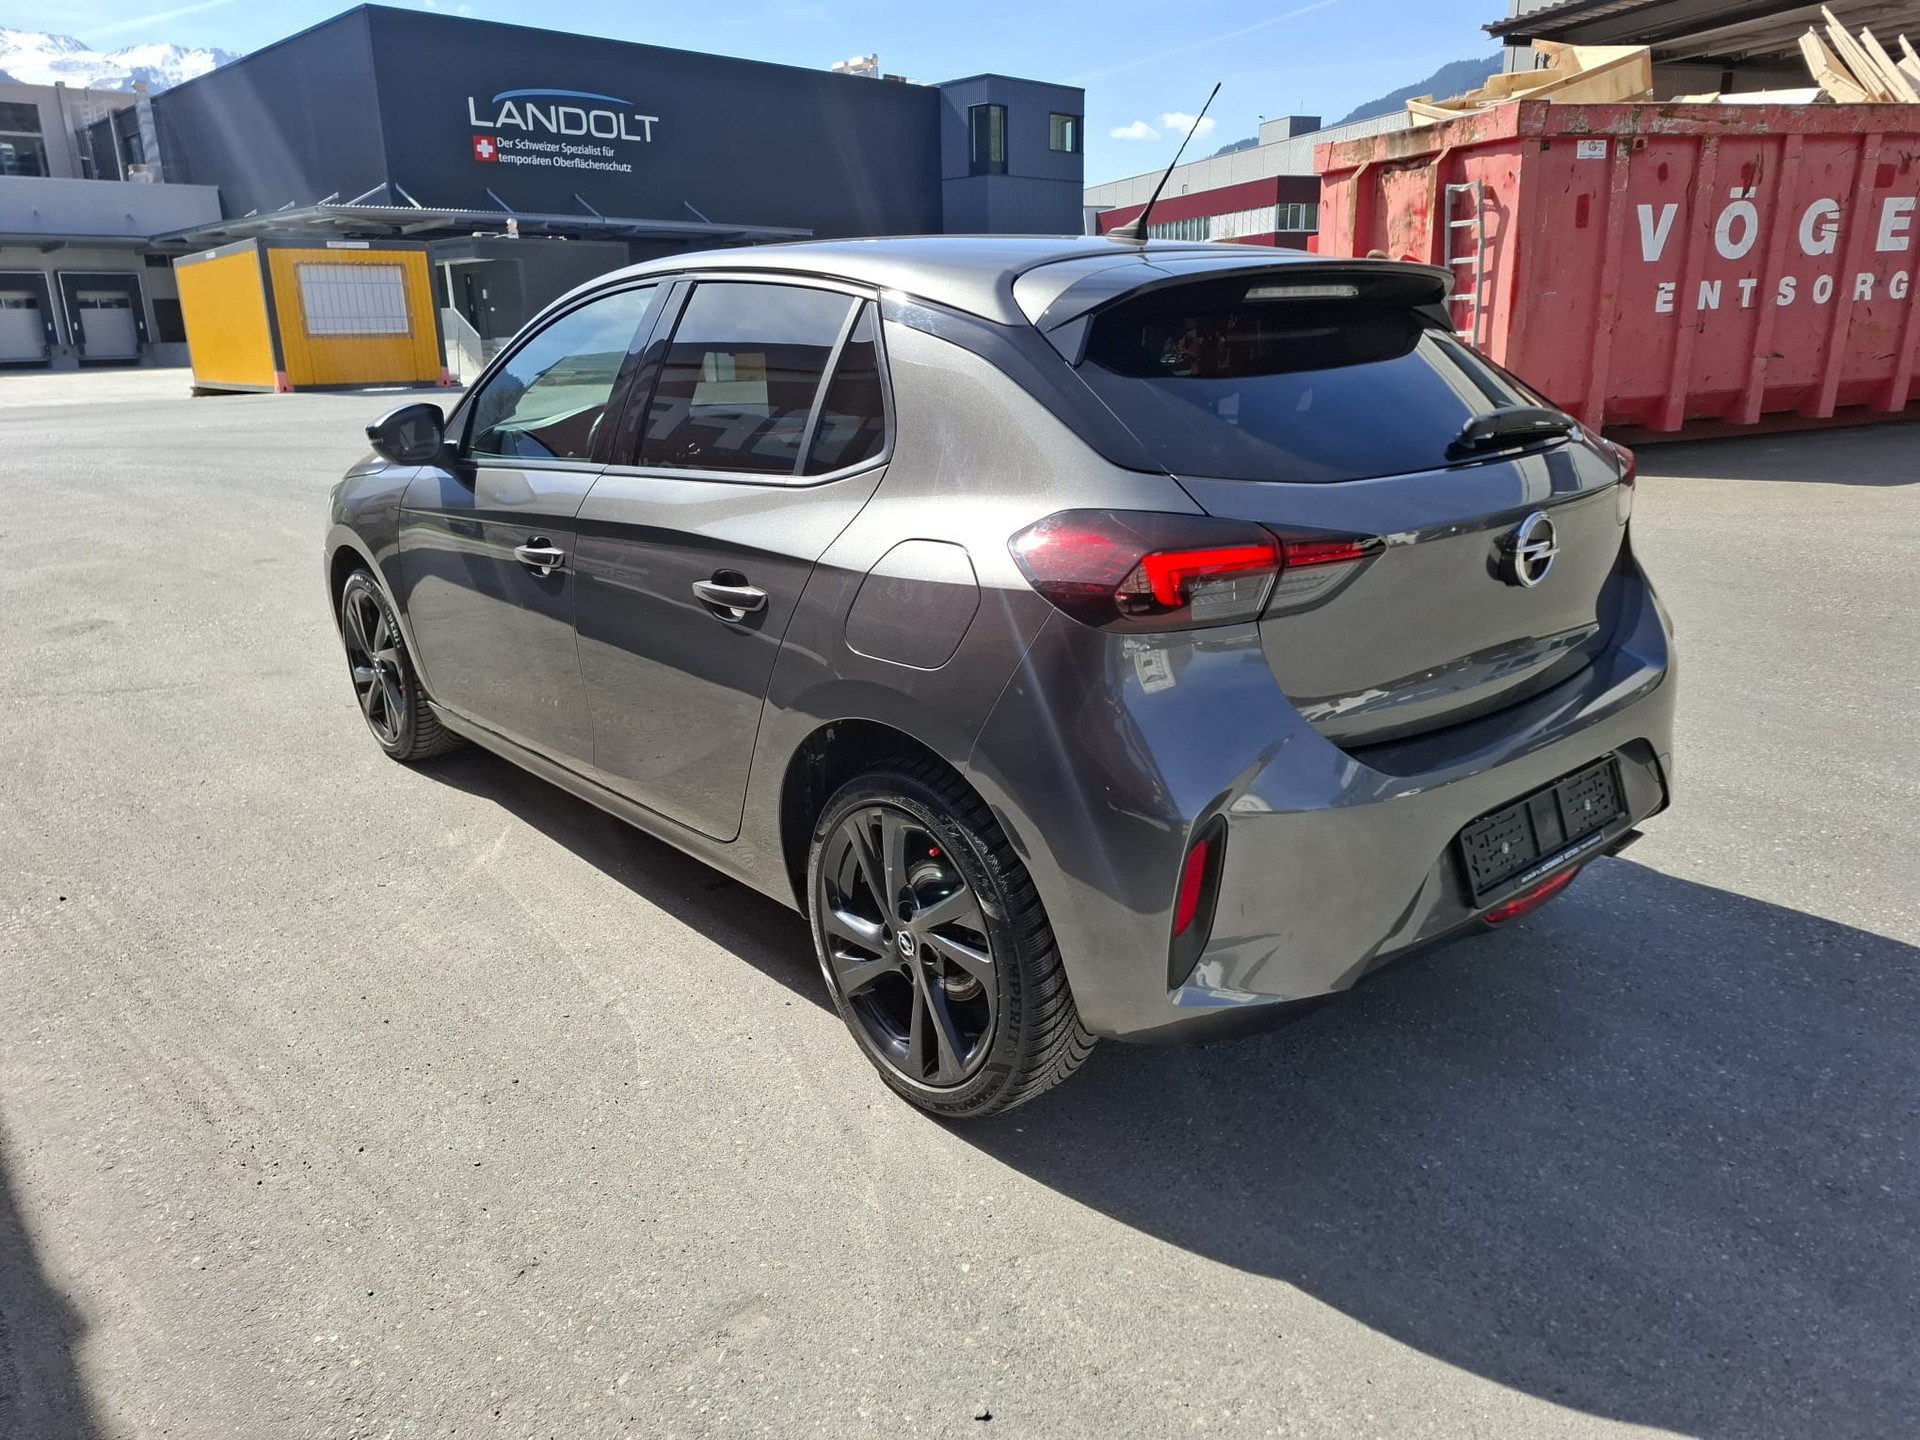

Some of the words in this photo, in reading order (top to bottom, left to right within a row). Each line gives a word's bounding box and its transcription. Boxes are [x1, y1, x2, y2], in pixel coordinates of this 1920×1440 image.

[468, 97, 659, 142] LANDOLT
[496, 137, 514, 149] Der
[515, 138, 561, 153] Schweizer
[561, 142, 601, 156] Spezialist
[602, 145, 615, 157] für
[498, 153, 552, 166] temporären
[552, 156, 632, 172] Oberflächenschutz
[1637, 186, 1918, 262] VÖGE
[1655, 270, 1910, 313] ENTSORG
[1003, 940, 1023, 1046] EMPERIT
